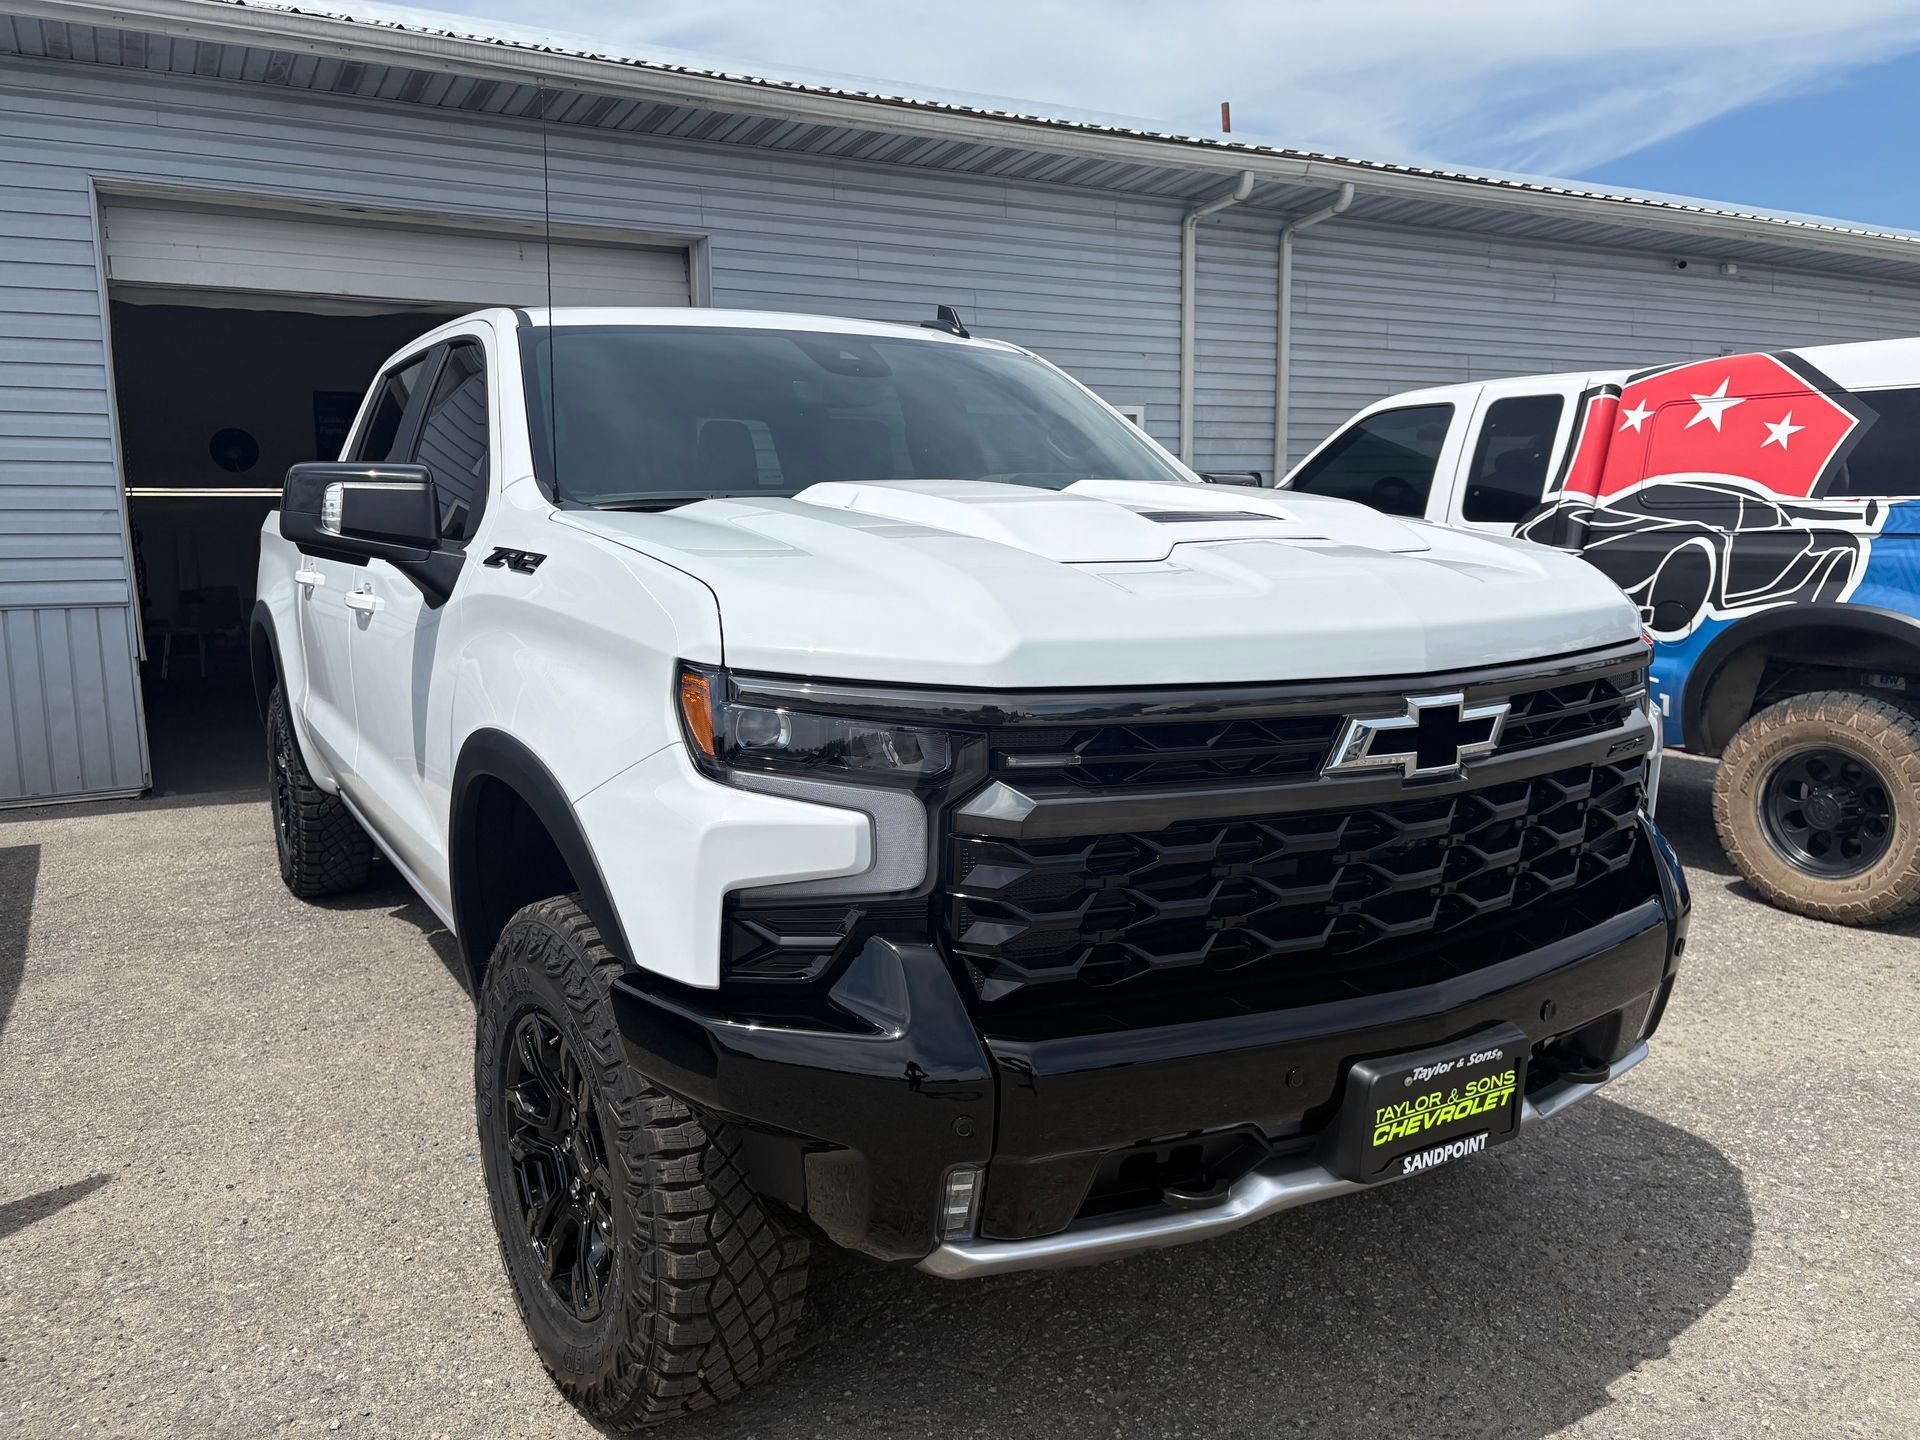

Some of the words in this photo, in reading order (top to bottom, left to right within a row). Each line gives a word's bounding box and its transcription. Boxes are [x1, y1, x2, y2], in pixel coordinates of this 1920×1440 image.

[1411, 1060, 1455, 1082] Taylor
[1456, 1058, 1465, 1068] &
[1467, 1048, 1499, 1067] Sons
[1373, 1087, 1515, 1147] CHEVROLET
[1376, 1091, 1443, 1124] TAYLOR
[1447, 1088, 1459, 1105] &
[1465, 1070, 1516, 1096] SONS
[1402, 1133, 1489, 1174] SANDPOINT
